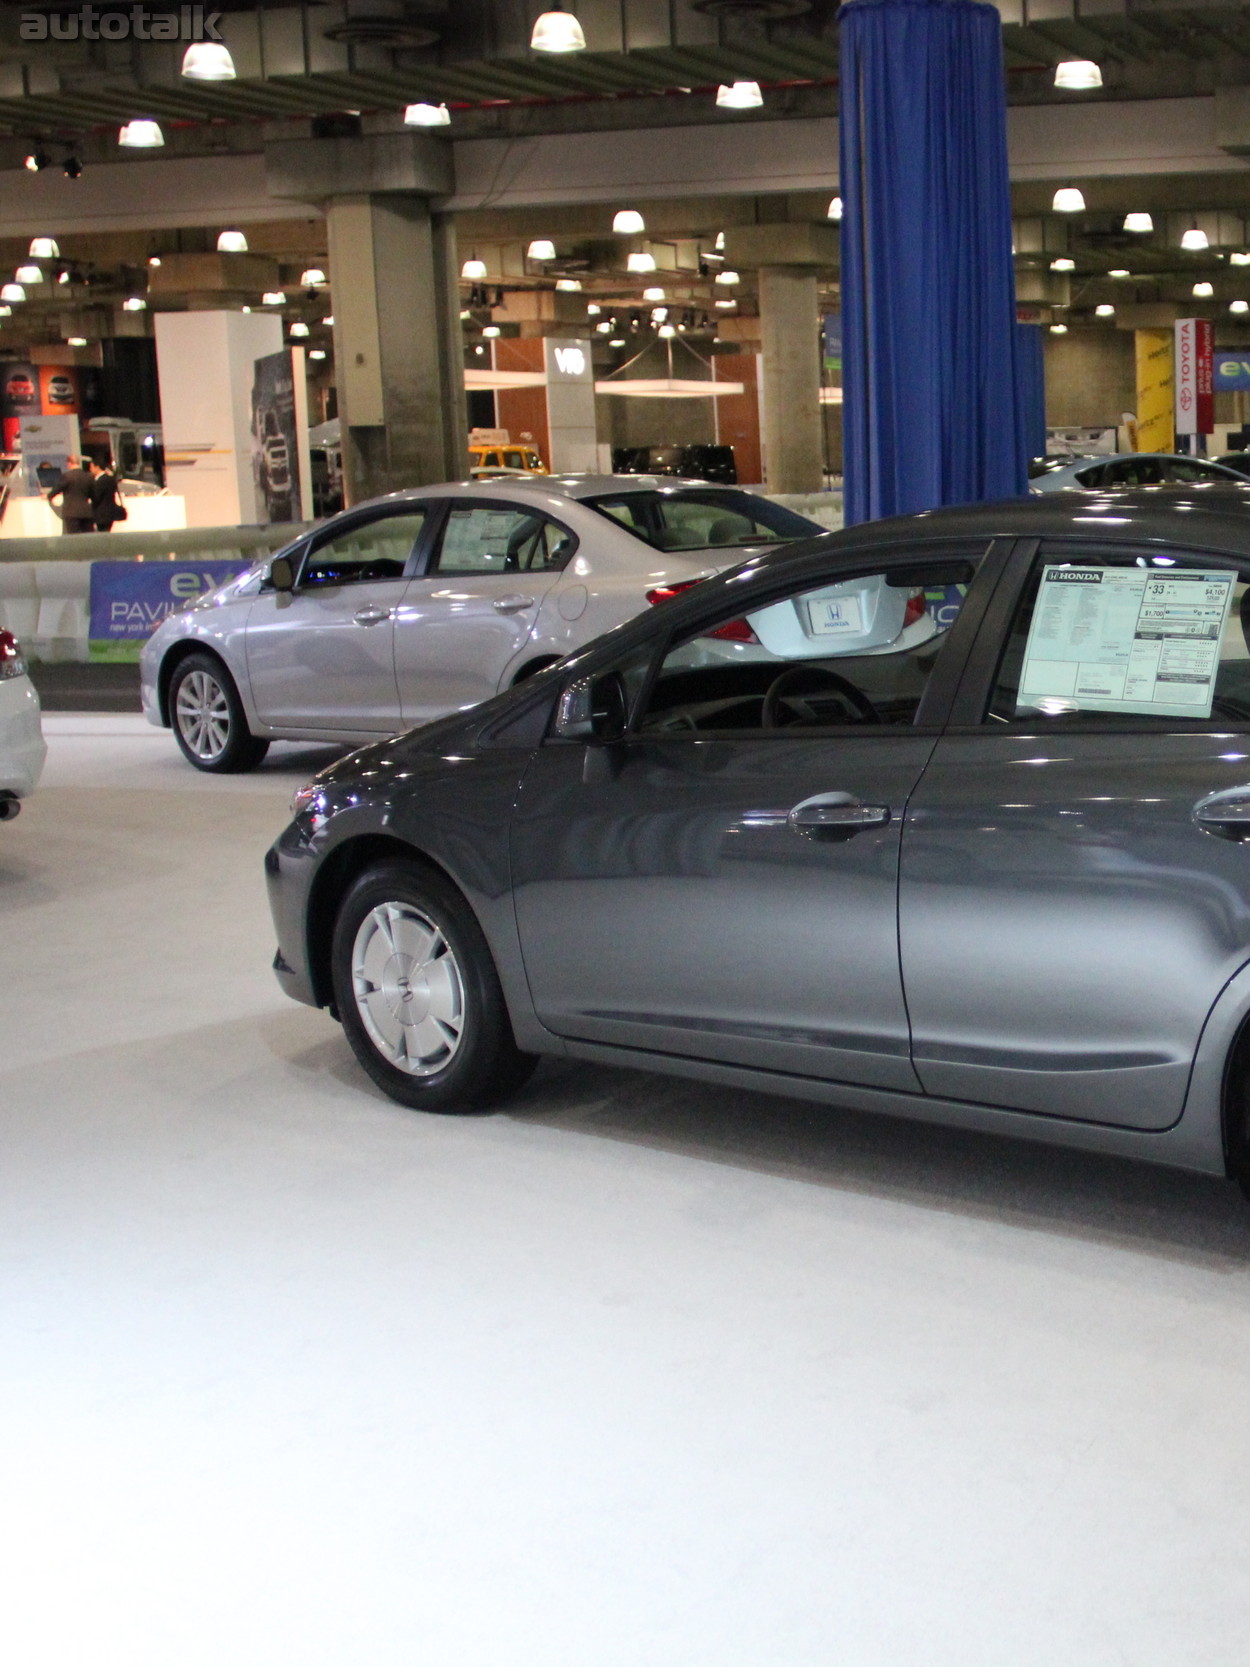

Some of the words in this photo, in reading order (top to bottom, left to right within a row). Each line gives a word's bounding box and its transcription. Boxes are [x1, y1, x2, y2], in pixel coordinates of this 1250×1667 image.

[1181, 323, 1190, 384] TOYOTA
[1059, 572, 1101, 581] HONDA
[1152, 584, 1165, 595] 33
[1205, 588, 1226, 596] $4,100
[110, 624, 126, 632] new
[127, 622, 145, 633] york
